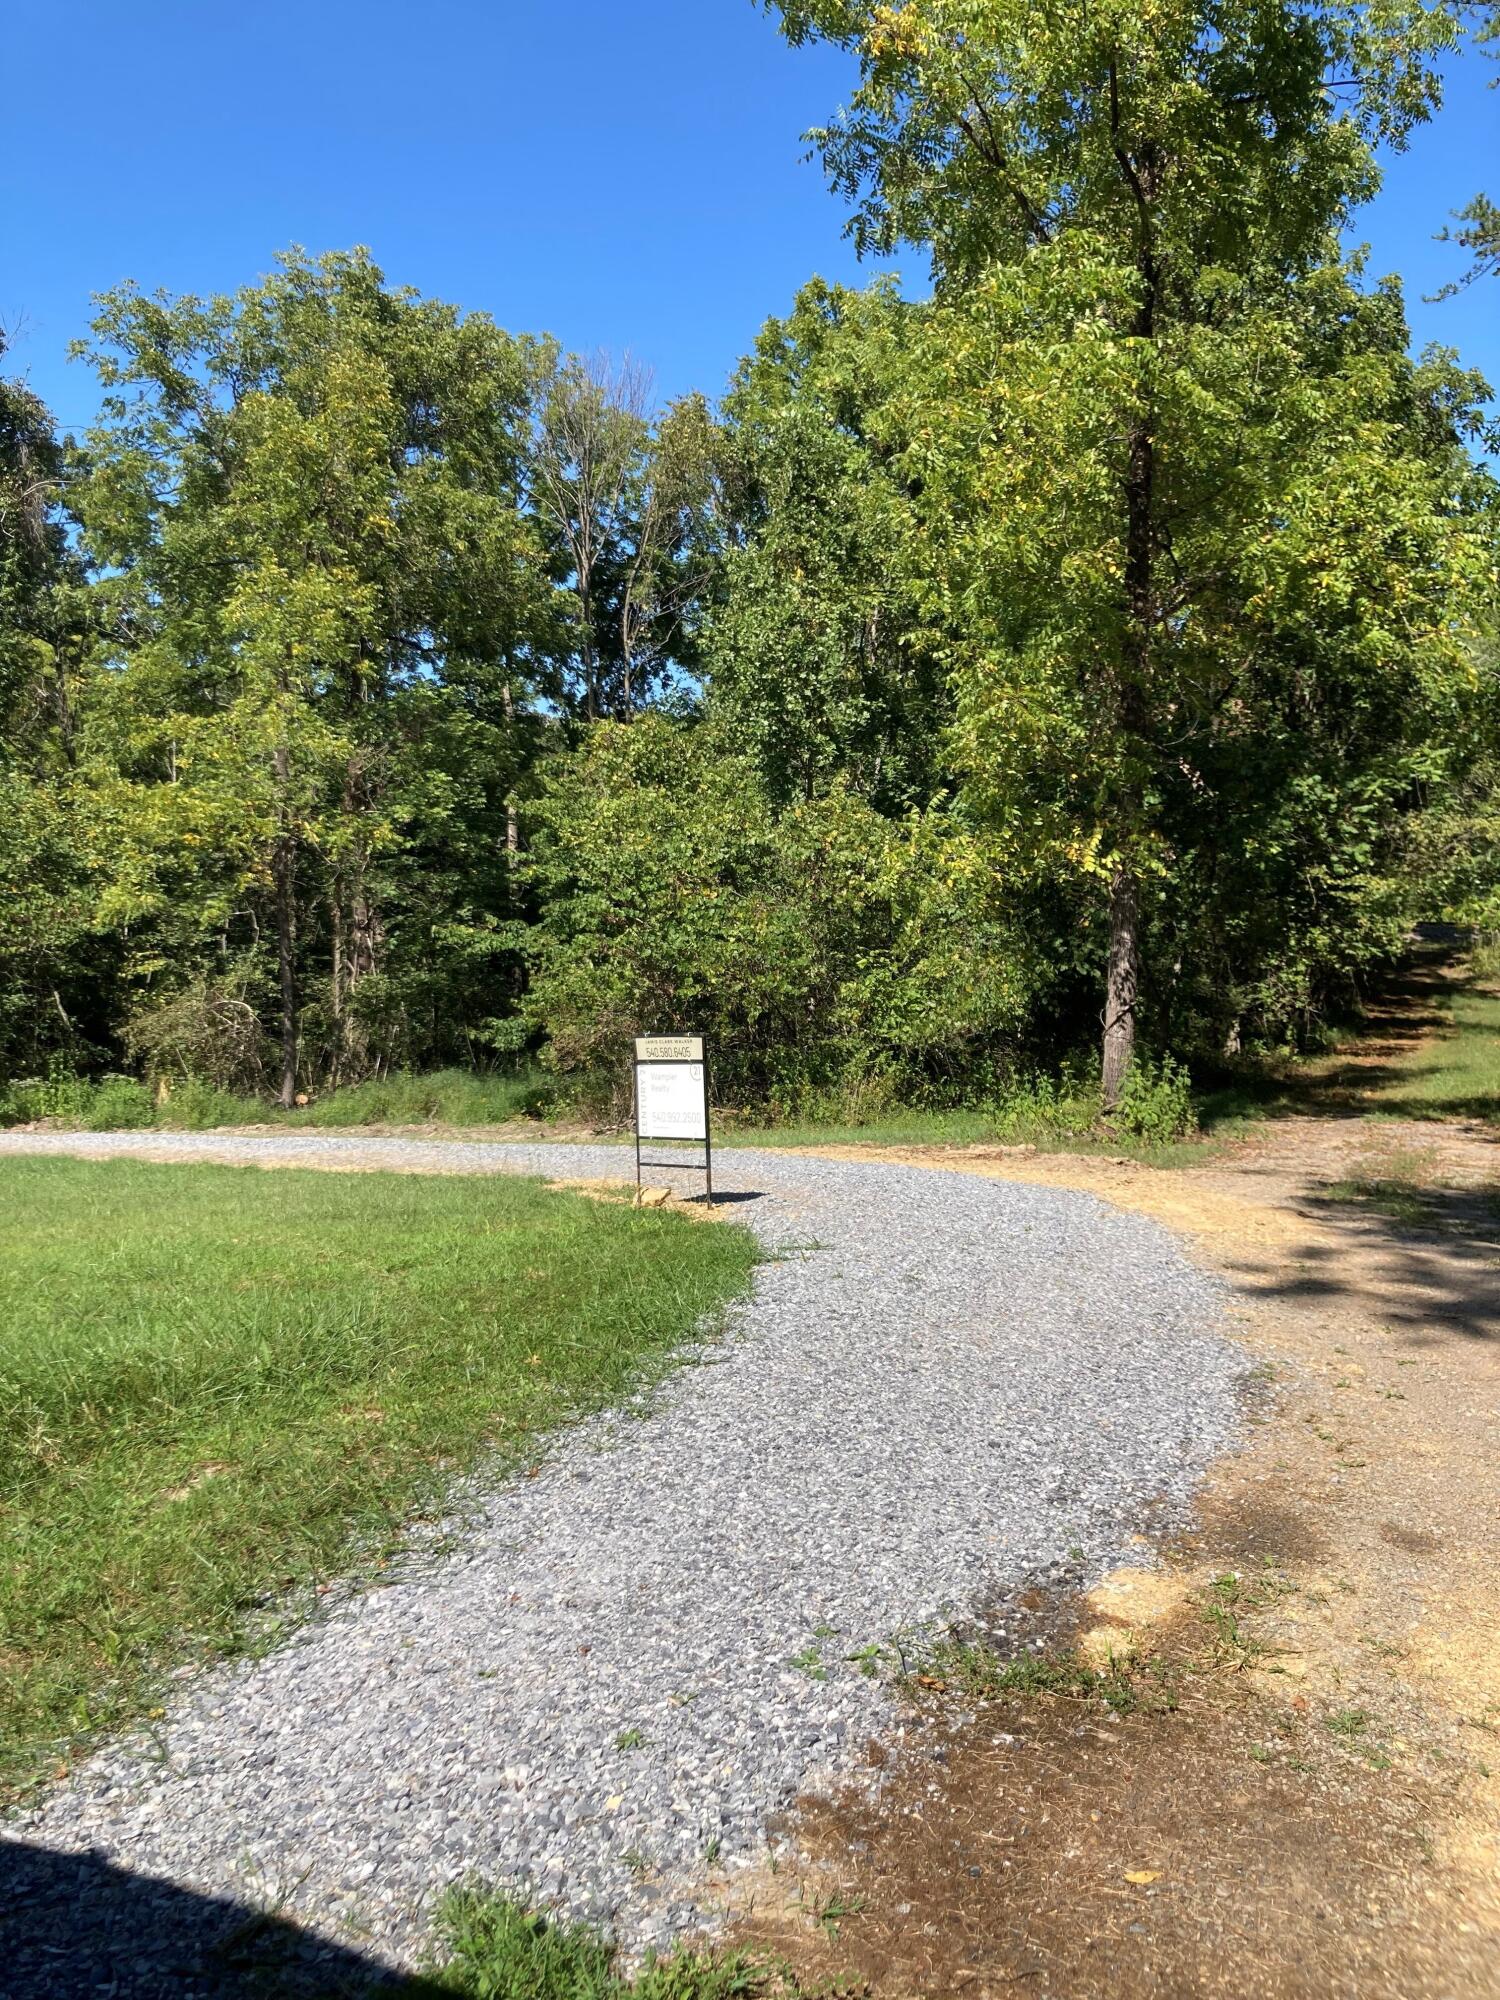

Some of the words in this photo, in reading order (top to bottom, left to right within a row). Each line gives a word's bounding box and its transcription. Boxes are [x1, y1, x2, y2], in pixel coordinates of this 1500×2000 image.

[646, 1046, 692, 1058] 540.580.6405
[693, 1065, 701, 1077] 21
[639, 1078, 648, 1135] CENTURY
